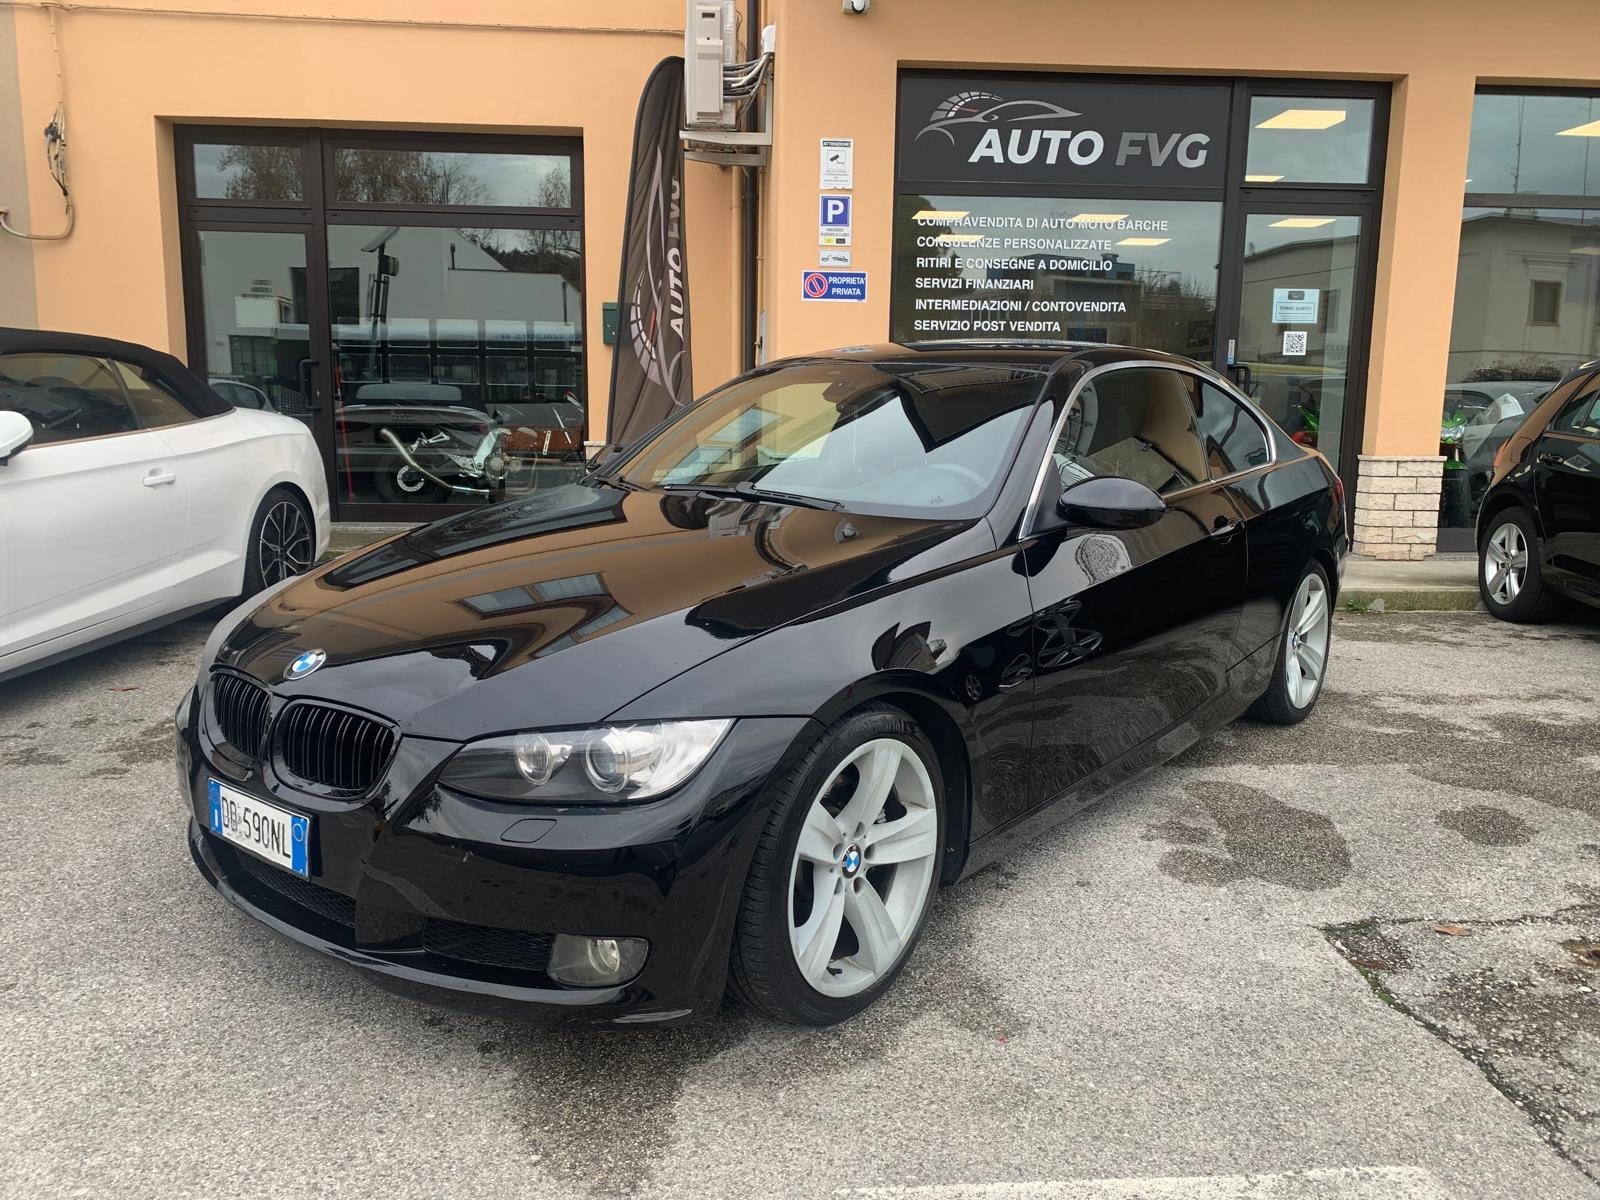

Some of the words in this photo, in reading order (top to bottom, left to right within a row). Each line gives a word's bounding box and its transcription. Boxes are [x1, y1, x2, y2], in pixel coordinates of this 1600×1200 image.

[968, 128, 1104, 165] AUTO
[1115, 131, 1211, 169] FVG
[827, 199, 845, 223] P
[917, 216, 1023, 229] COMPRAVENDITA
[1026, 217, 1038, 229] DI
[1041, 219, 1075, 230] AUTO
[1078, 219, 1115, 231] MOTO
[1117, 220, 1169, 231] BARCHE
[916, 236, 1001, 249] CONSULENZE
[1003, 238, 1112, 251] PERSONALIZZATE
[916, 257, 951, 269] RITIRI
[954, 258, 963, 269] E
[966, 258, 1035, 270] CONSEGNE
[1038, 259, 1047, 270] A
[1049, 259, 1113, 272] DOMICILIO
[915, 277, 962, 290] SERVIZI
[965, 279, 1034, 290] FINANZIARI
[667, 247, 684, 341] AUTO
[831, 287, 862, 296] PRIVATA
[915, 298, 1022, 312] INTERMEDIAZIONI
[1024, 301, 1030, 312] /
[1032, 301, 1127, 313] CONTOVENDITA
[914, 319, 971, 332] SERVIZIO
[973, 320, 1007, 332] POST
[1009, 321, 1061, 333] VENDITA
